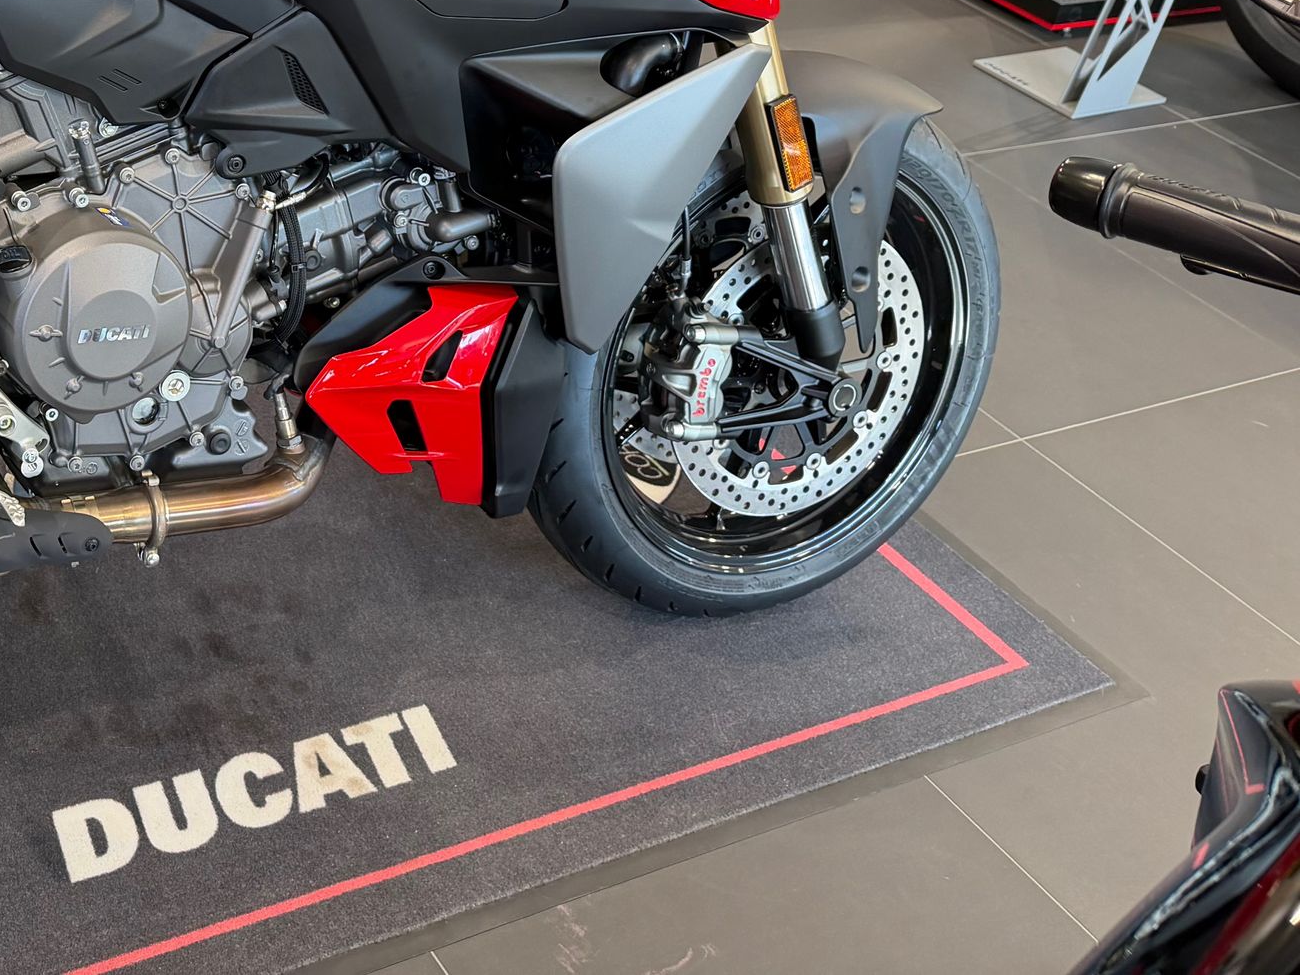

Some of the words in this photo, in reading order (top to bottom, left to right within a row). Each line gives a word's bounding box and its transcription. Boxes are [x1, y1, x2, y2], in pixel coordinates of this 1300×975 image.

[77, 325, 151, 344] DUCATI
[692, 358, 717, 417] brembo
[52, 704, 457, 884] DUCATI
